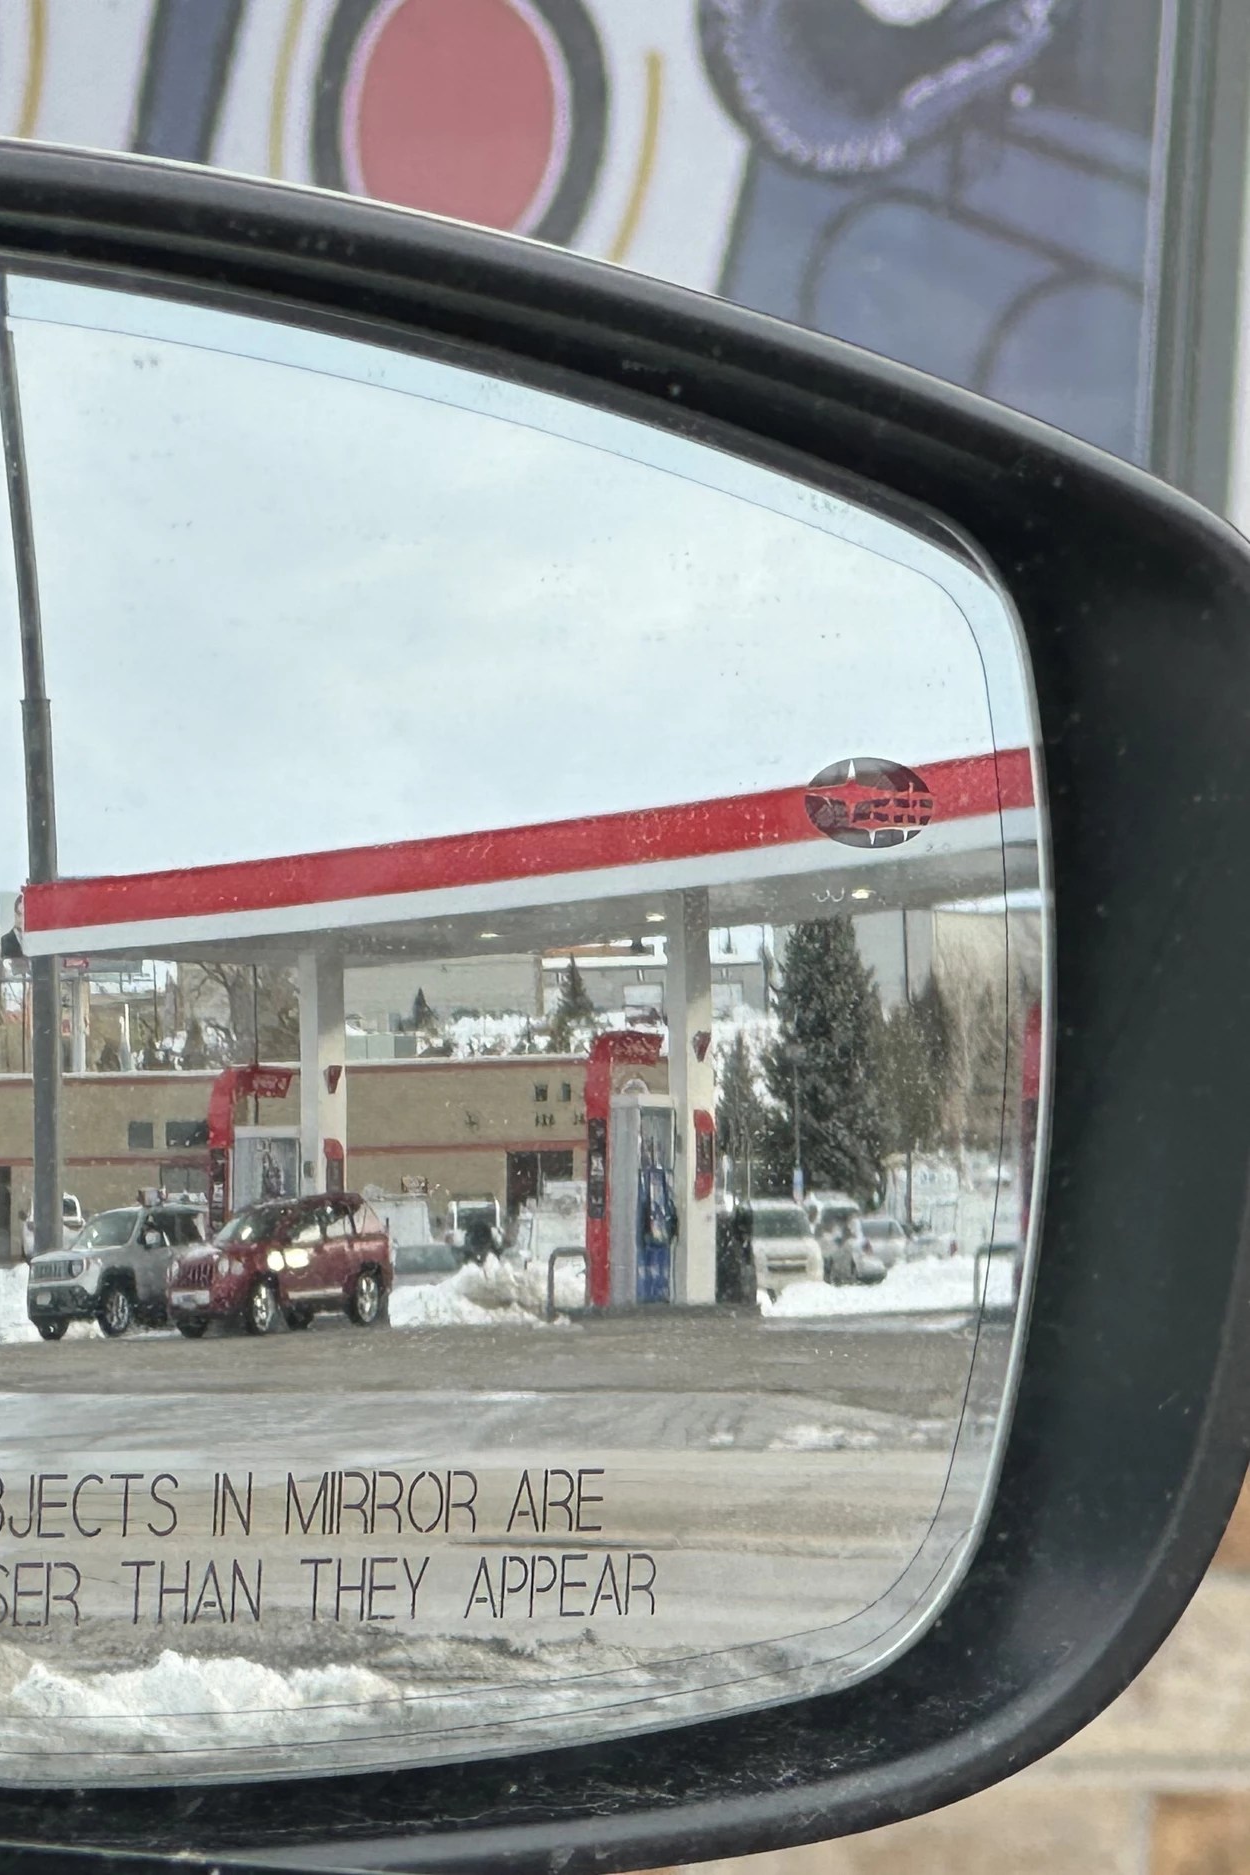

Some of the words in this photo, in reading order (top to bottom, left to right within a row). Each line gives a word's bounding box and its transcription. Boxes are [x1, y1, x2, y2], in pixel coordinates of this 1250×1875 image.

[212, 1471, 252, 1537] IN
[285, 1470, 478, 1535] MIRROR
[506, 1468, 605, 1533] ARE
[121, 1559, 262, 1625] THAN
[300, 1556, 430, 1622] THEY
[463, 1553, 657, 1619] APPEAR
